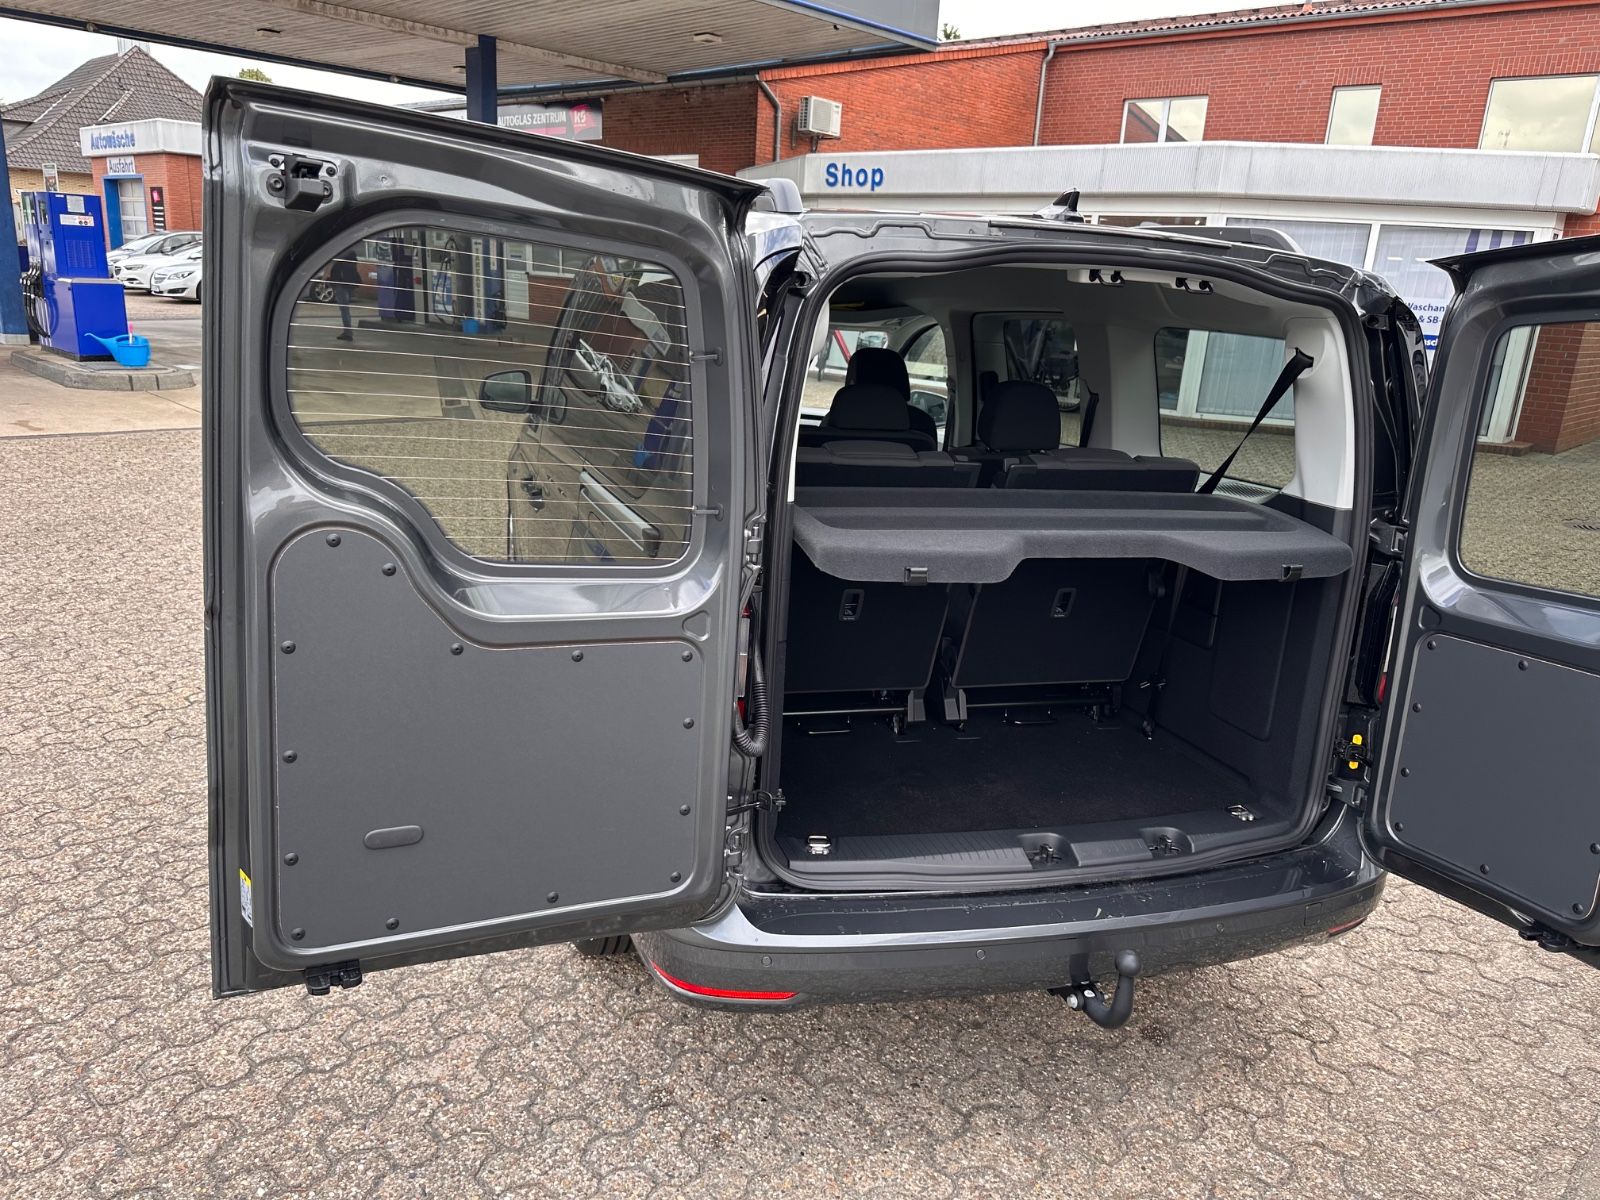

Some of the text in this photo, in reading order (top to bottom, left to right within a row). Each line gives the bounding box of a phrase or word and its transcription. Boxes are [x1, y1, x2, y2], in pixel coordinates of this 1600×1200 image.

[497, 111, 567, 126] AUTOGLAS ZENTRUM
[108, 158, 134, 174] Ausfahrt
[825, 162, 884, 192] Shop
